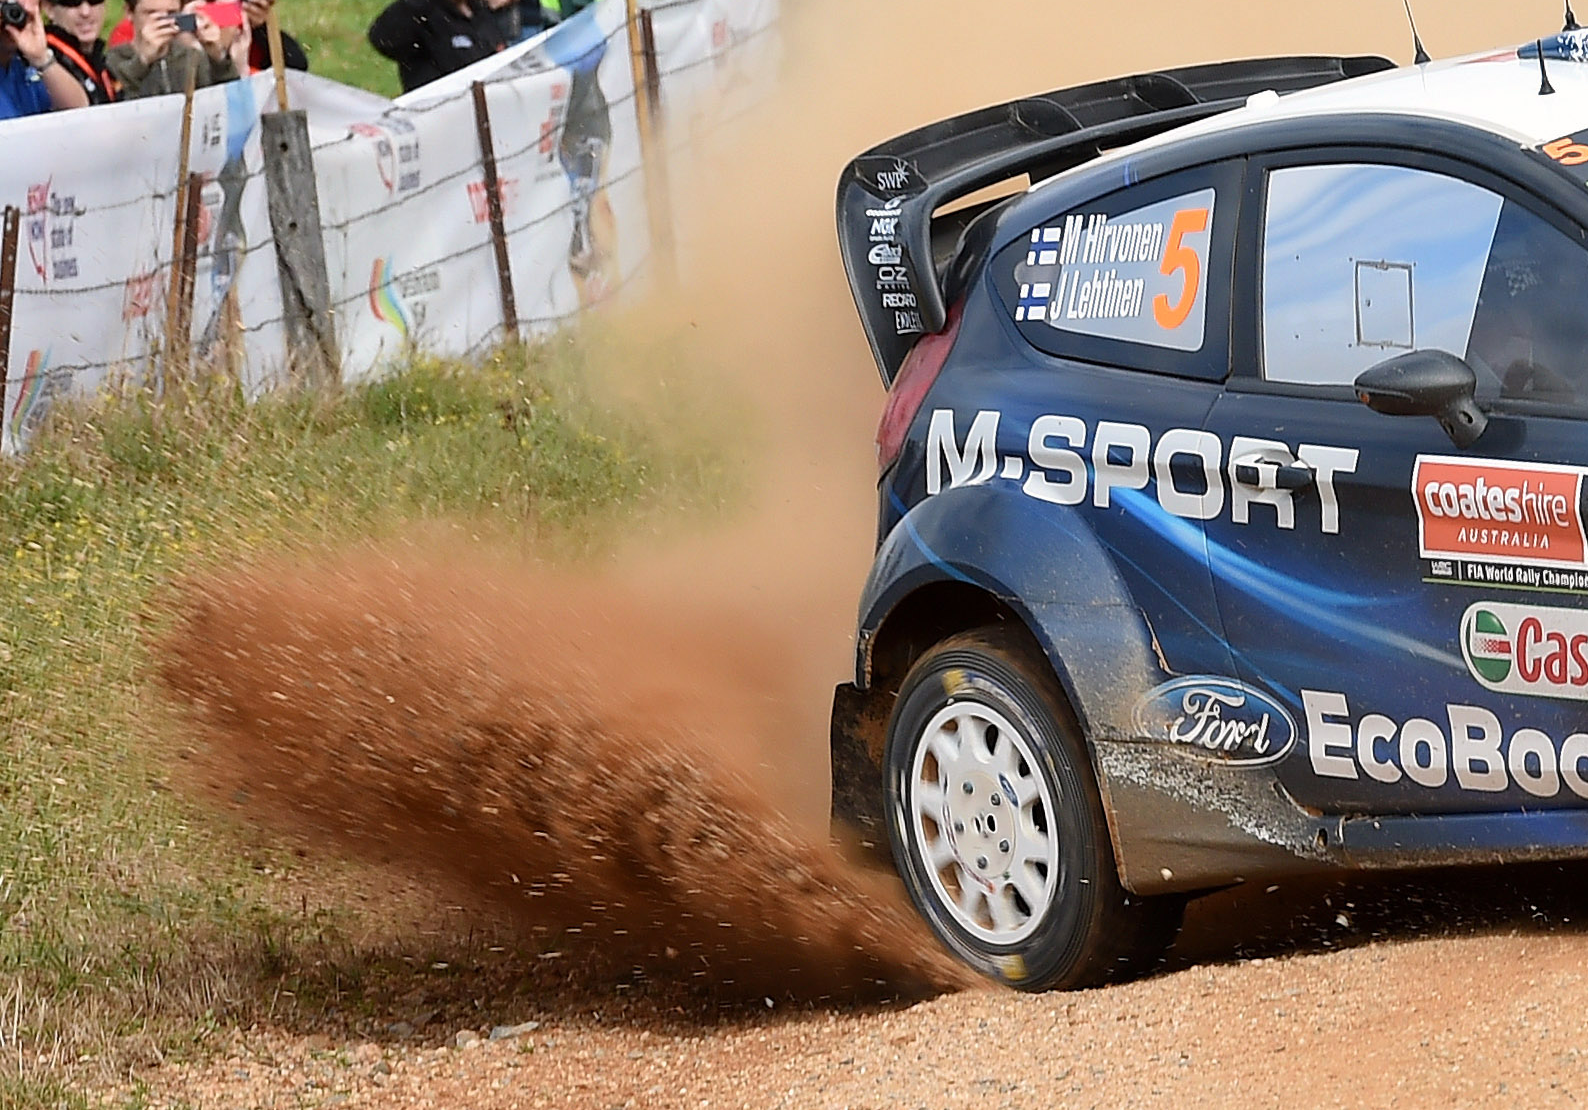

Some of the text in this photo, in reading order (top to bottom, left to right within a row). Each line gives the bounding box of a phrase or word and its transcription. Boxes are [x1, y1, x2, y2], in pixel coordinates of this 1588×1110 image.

[1059, 214, 1164, 265] M Hirvonen
[878, 266, 908, 281] OZ
[1051, 268, 1146, 320] J Lehtinen
[1152, 208, 1209, 330] 5
[926, 409, 1360, 534] M-SPORT
[1424, 476, 1570, 527] coateshire
[1457, 526, 1550, 550] AUSTRALIA
[1467, 563, 1484, 580] FIA
[1485, 564, 1513, 582] World
[1516, 568, 1540, 587] Rally
[1168, 688, 1270, 754] Ford
